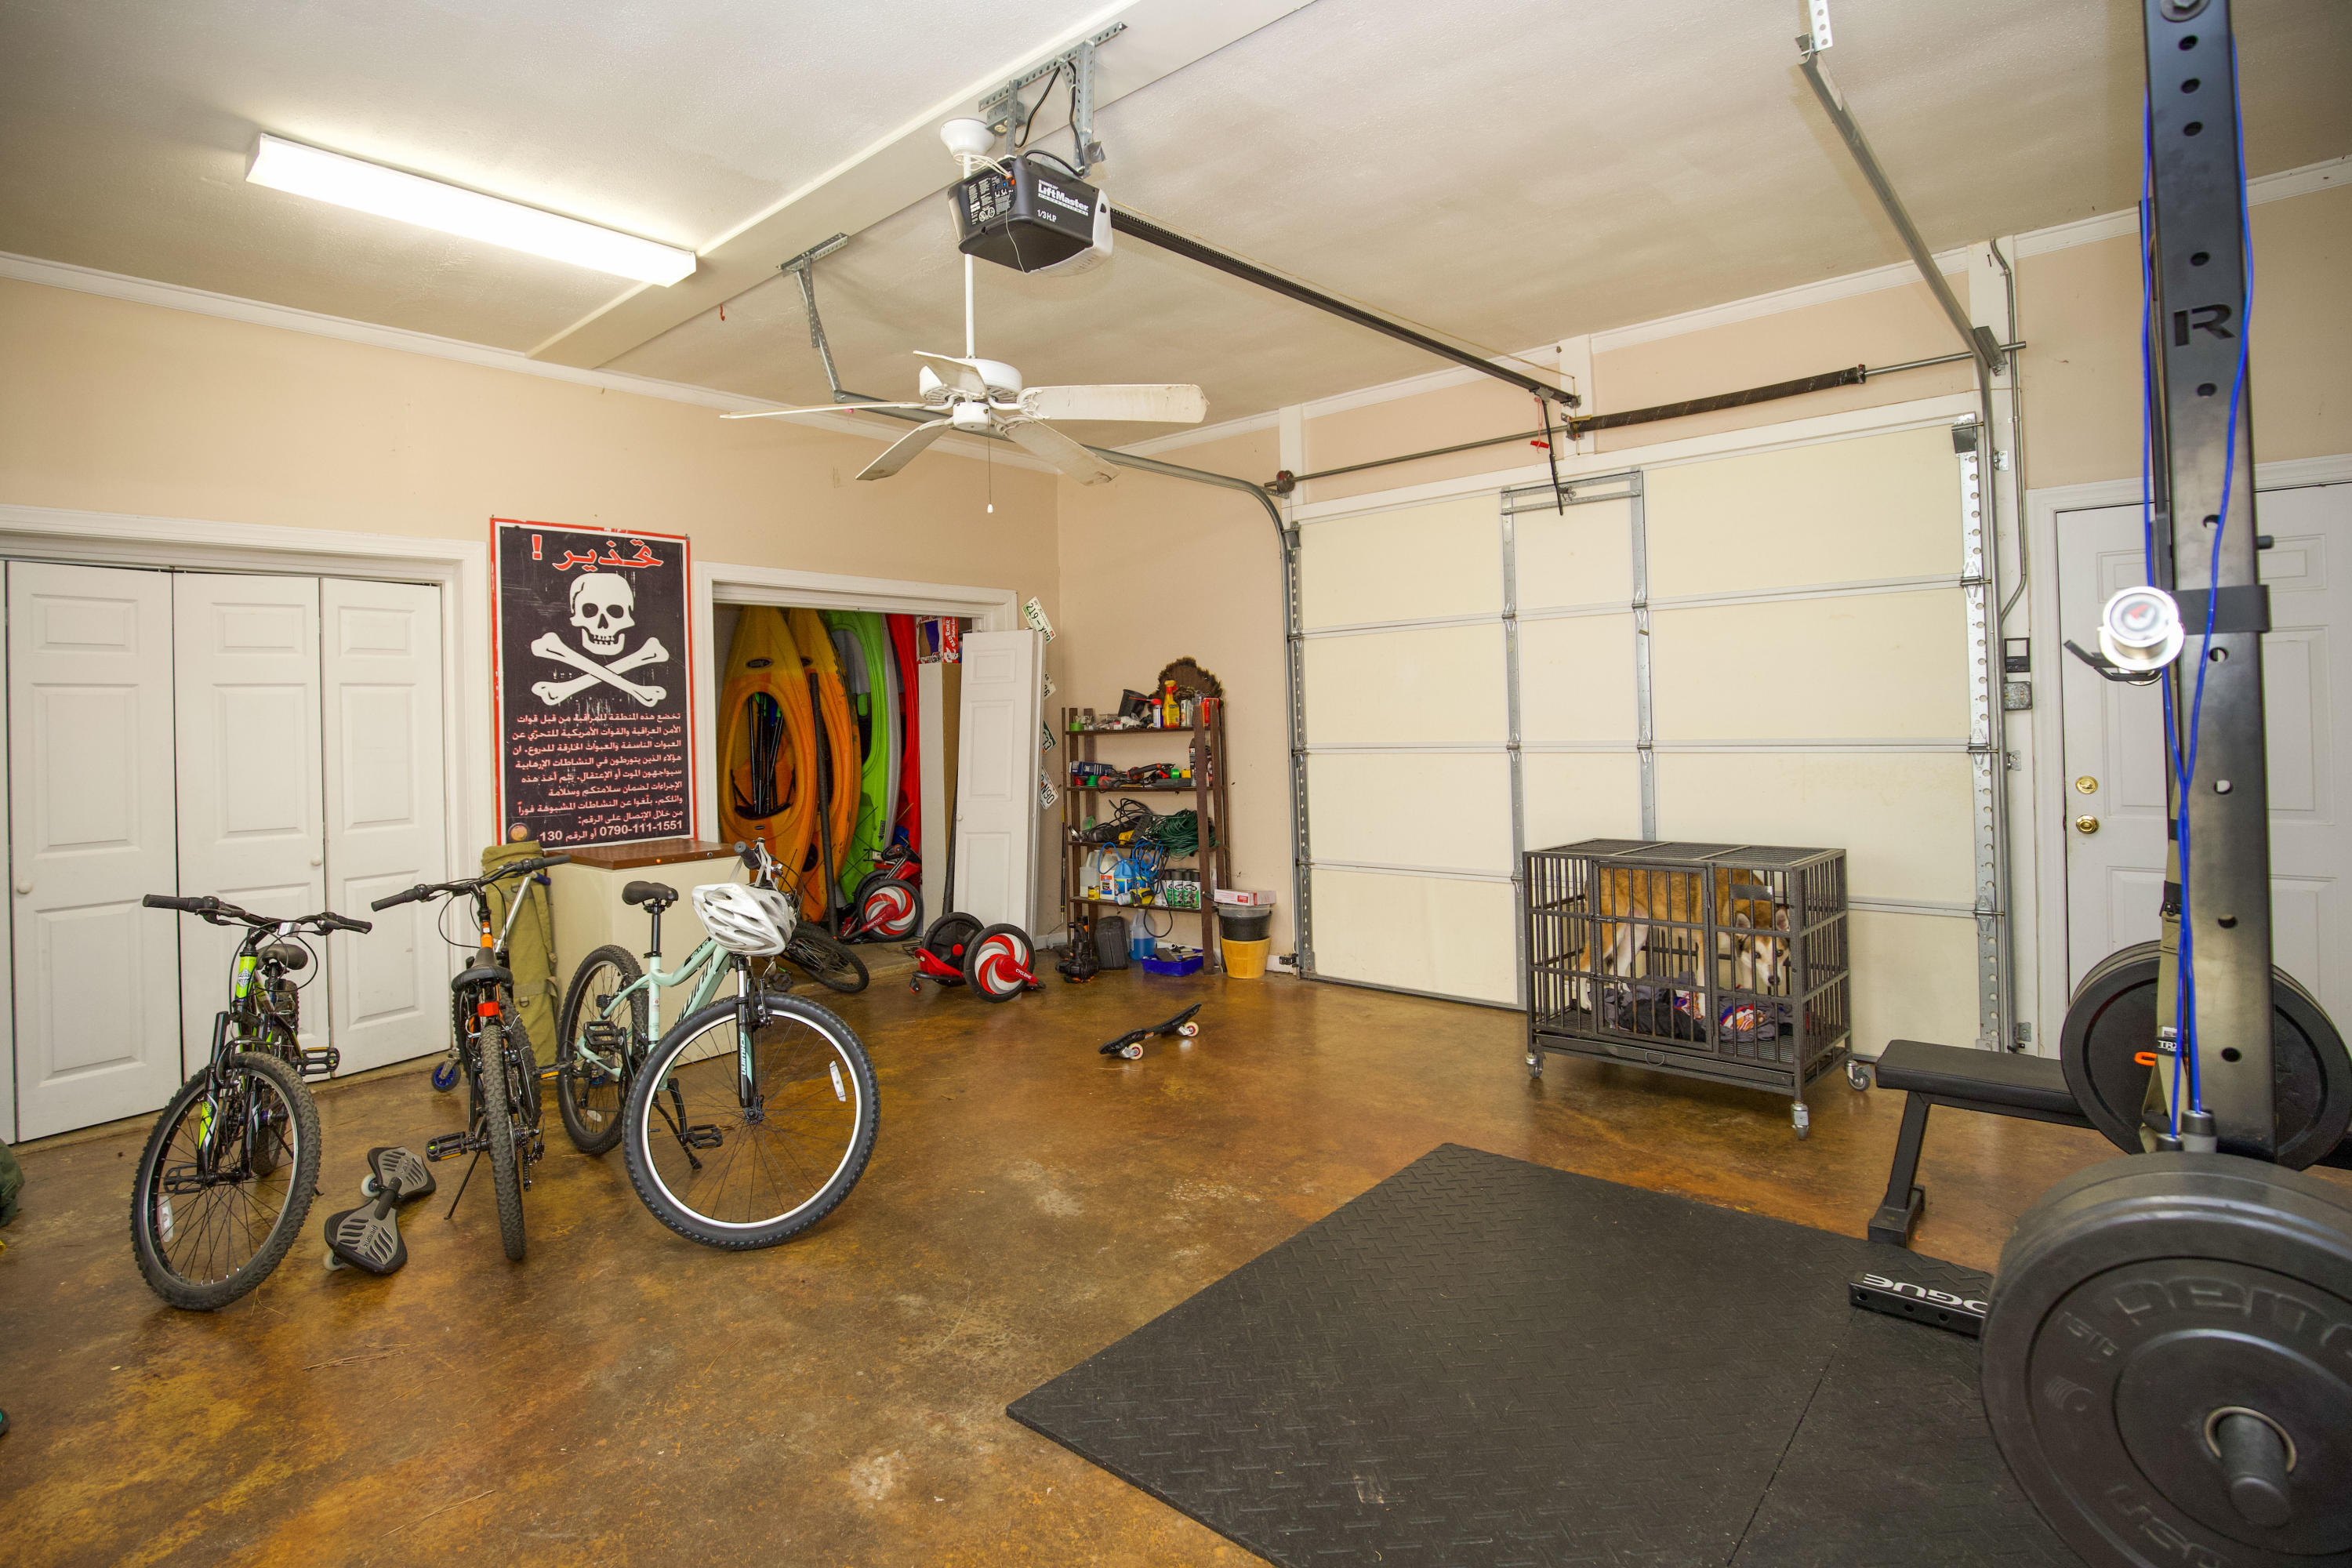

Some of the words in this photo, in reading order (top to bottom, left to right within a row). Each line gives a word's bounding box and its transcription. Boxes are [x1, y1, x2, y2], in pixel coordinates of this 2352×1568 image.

[1038, 183, 1089, 212] LiftMaster
[2173, 303, 2236, 347] R
[552, 539, 664, 572] تحذير
[600, 821, 682, 837] 0790-111-1551
[1863, 1273, 1988, 1314] OGUE
